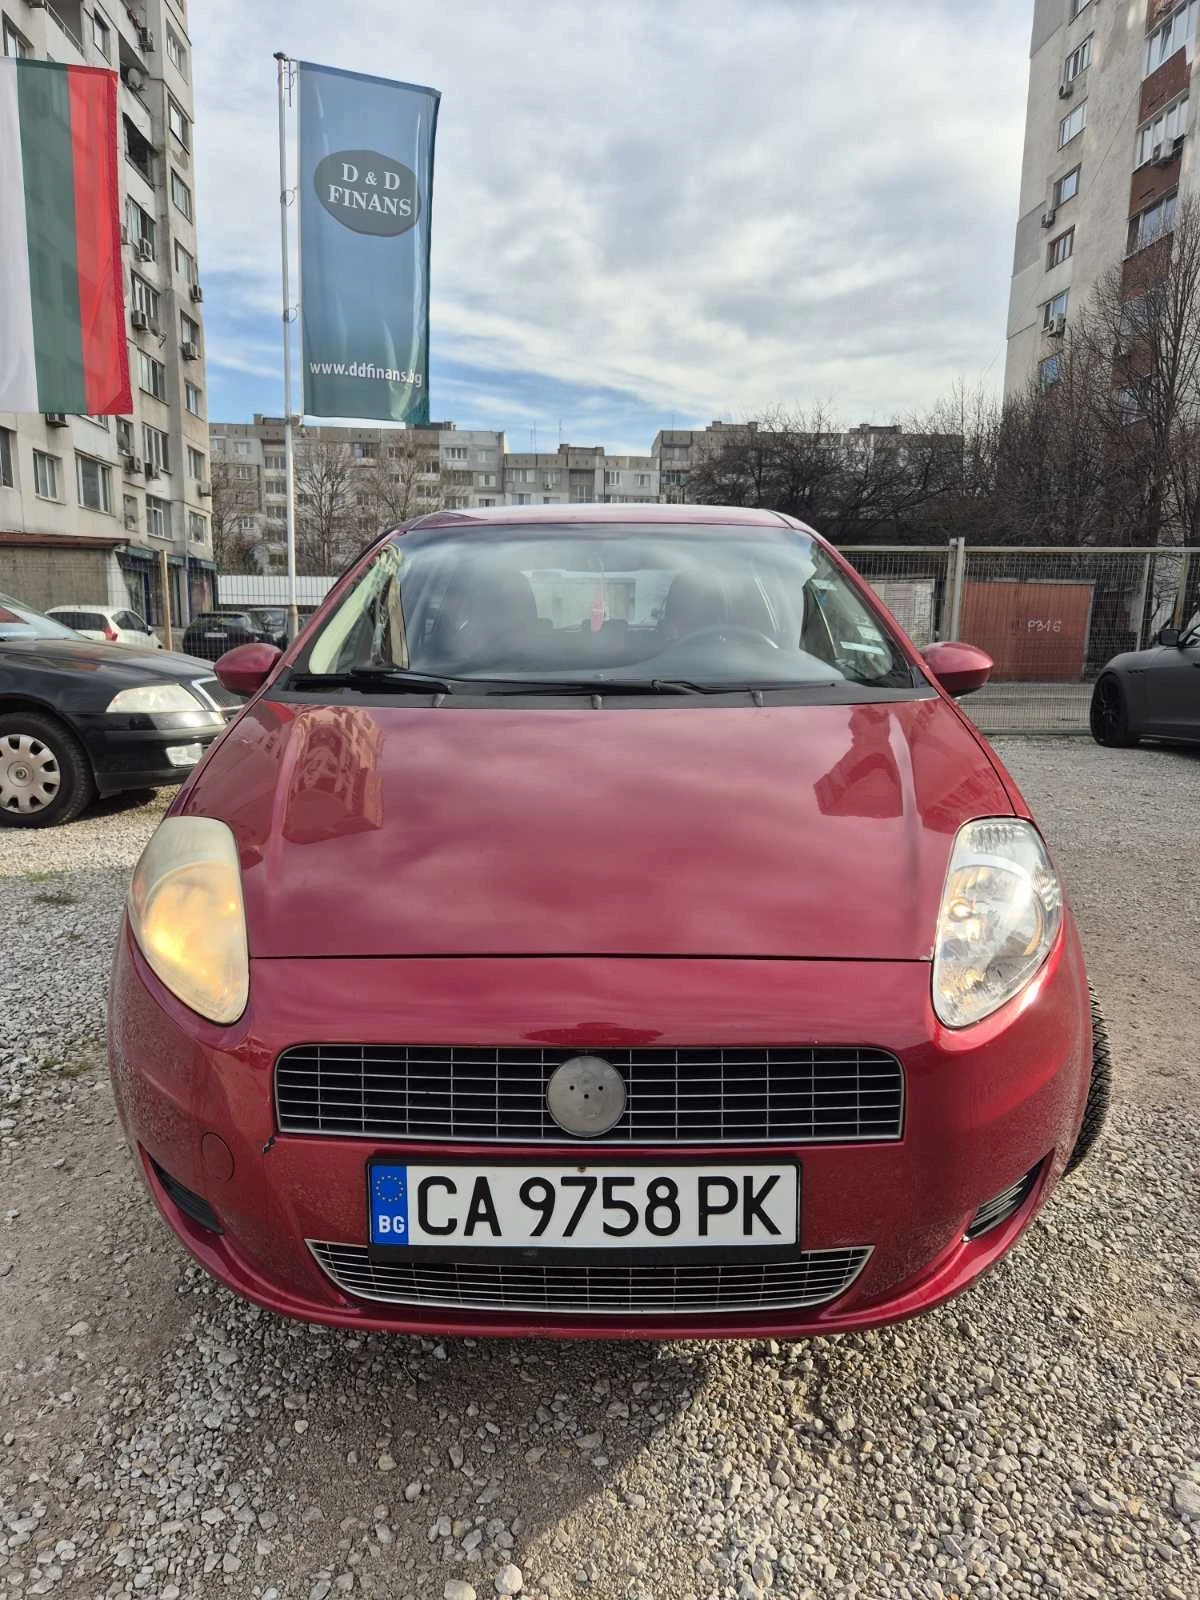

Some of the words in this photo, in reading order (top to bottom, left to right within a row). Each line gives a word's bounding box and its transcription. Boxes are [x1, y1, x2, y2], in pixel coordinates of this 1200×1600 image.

[341, 162, 359, 182] D
[365, 171, 378, 186] &
[383, 171, 400, 190] D
[328, 184, 412, 217] FINANS
[309, 361, 423, 388] www.ddfinans.bg
[417, 1176, 502, 1237] CA
[519, 1176, 680, 1237] 9758
[698, 1175, 782, 1236] PK
[378, 1215, 405, 1233] BG
